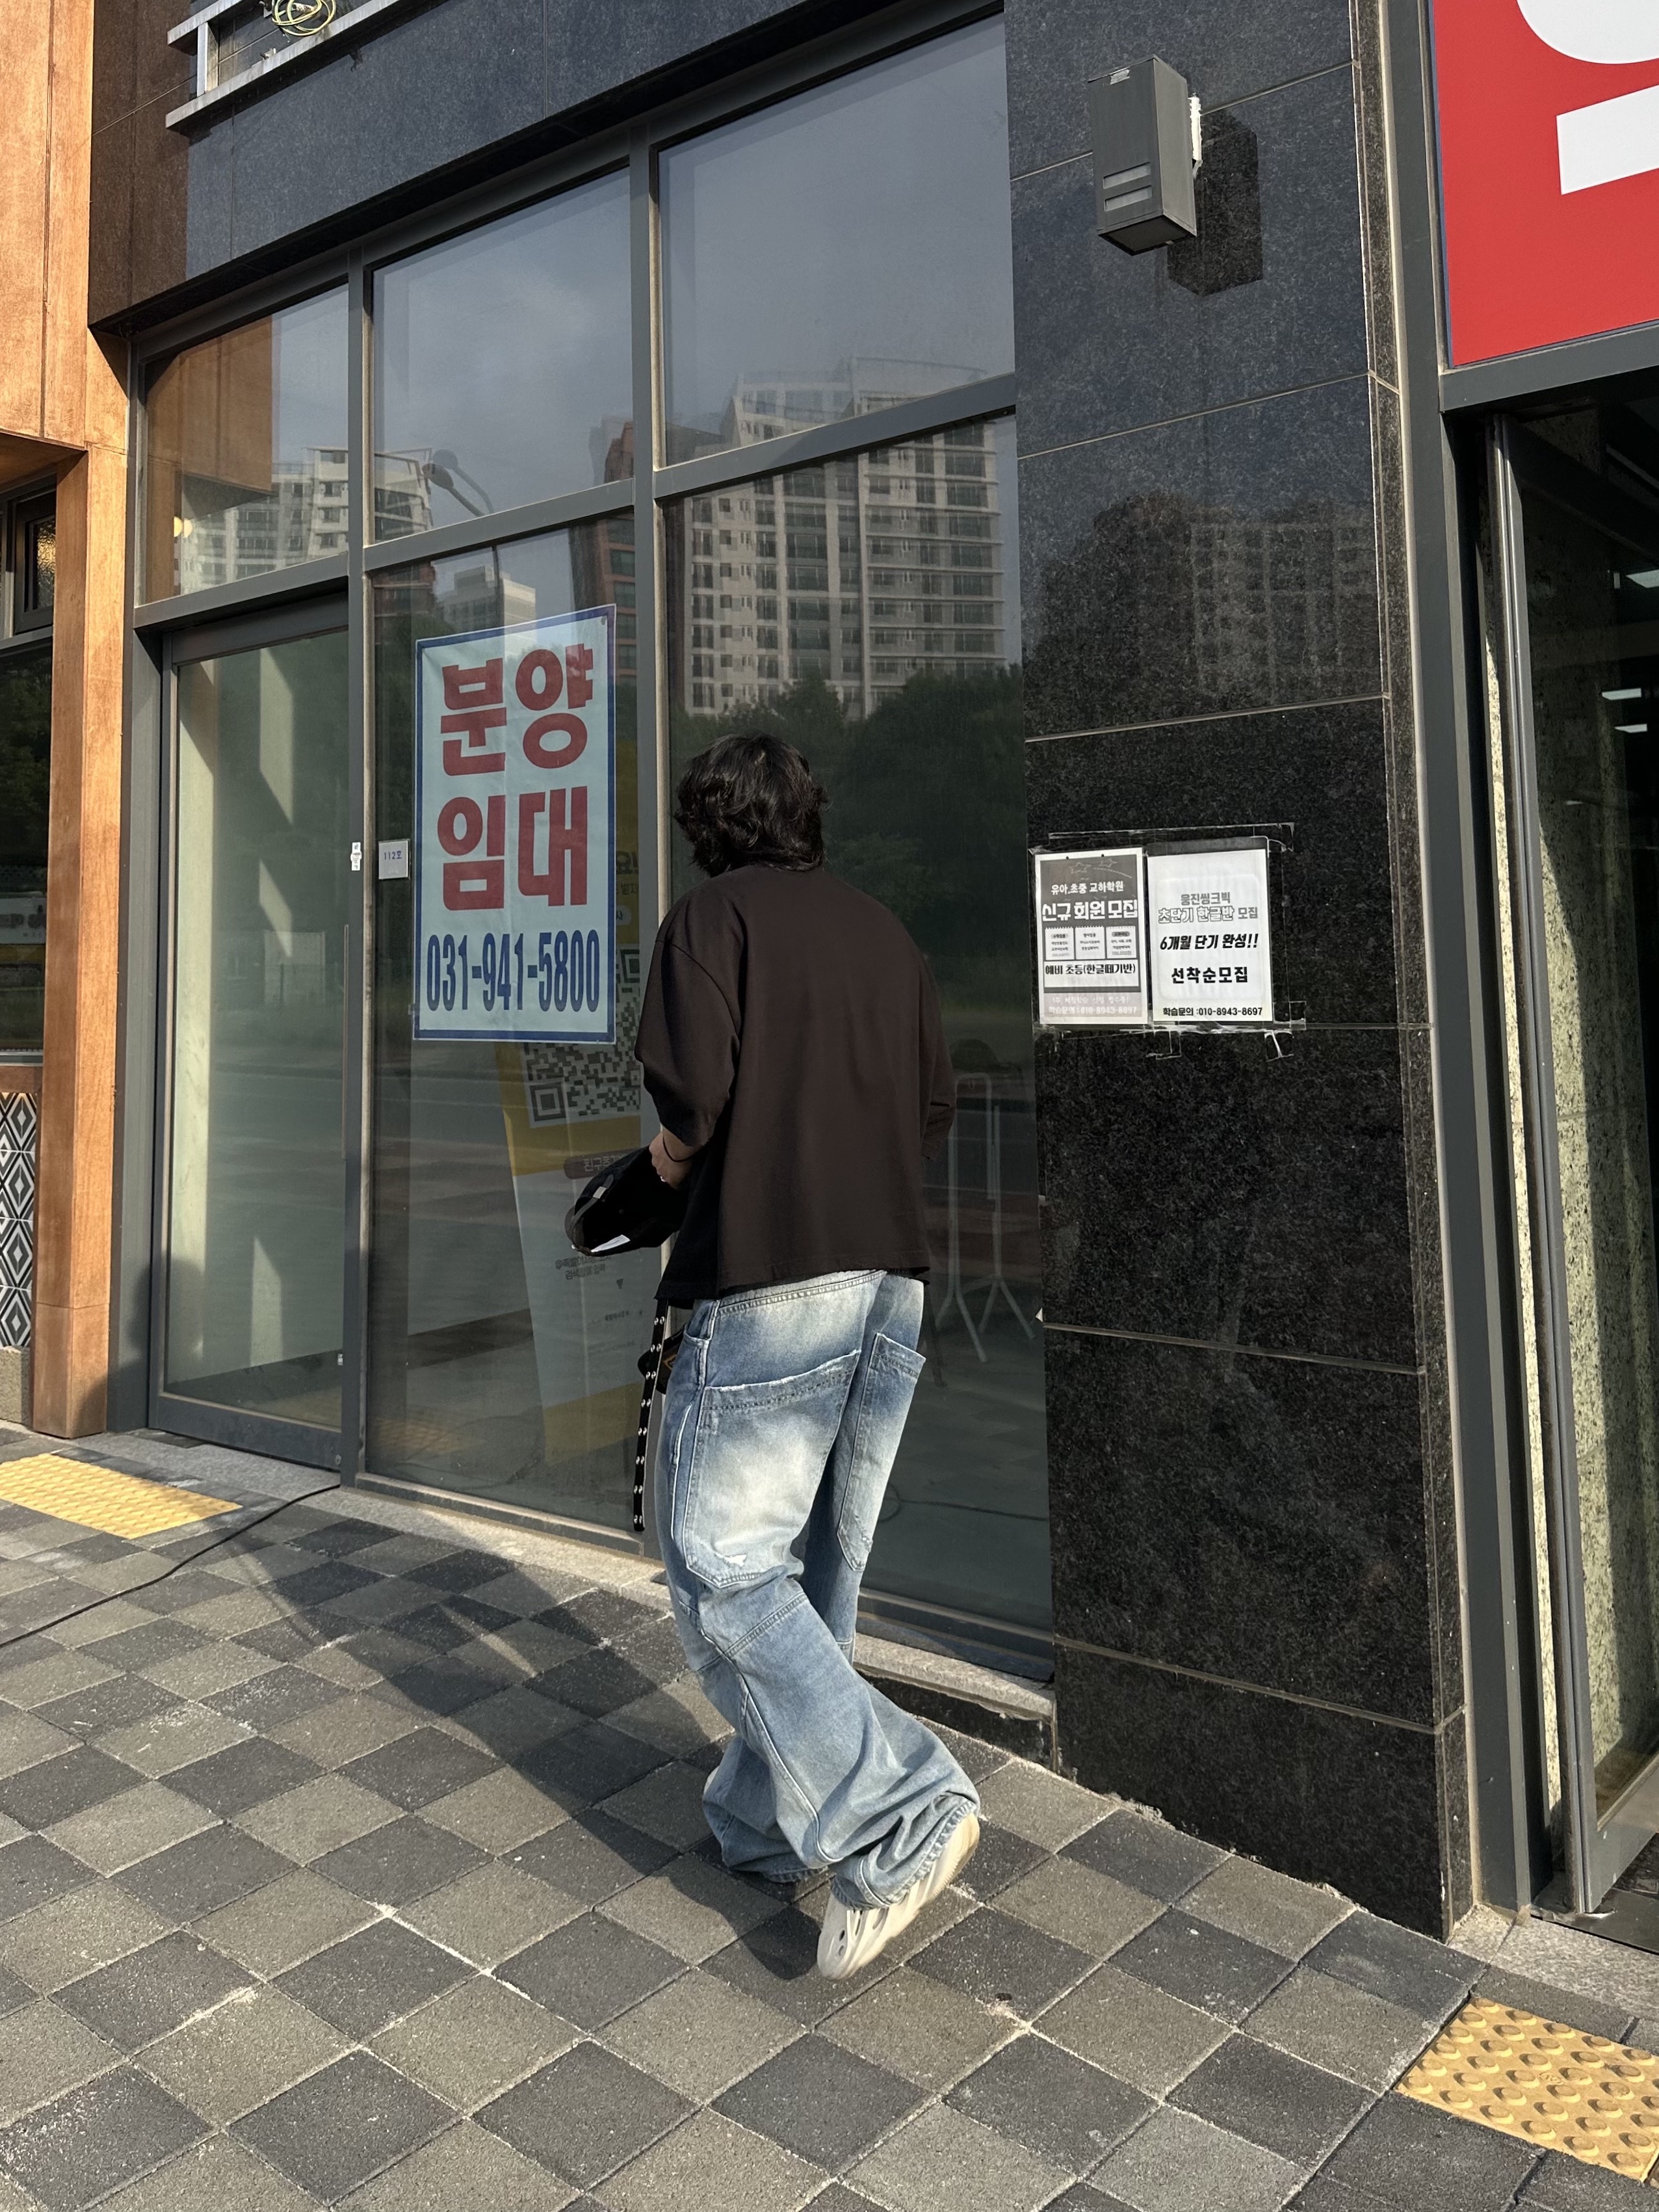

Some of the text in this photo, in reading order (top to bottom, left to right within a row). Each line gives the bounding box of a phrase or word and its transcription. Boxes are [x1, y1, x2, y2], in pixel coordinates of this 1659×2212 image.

[440, 642, 594, 776] 분양
[384, 850, 402, 860] 112호
[438, 786, 588, 910] 임대
[1090, 881, 1123, 892] 교하학원
[1181, 892, 1231, 906] 웅진씽크빅
[1042, 899, 1138, 921] 신규 회원 모집
[1158, 906, 1258, 924] 초단기 한글반 모집
[1160, 933, 1259, 950] 6개월 단기 완성!!
[427, 930, 599, 1012] 031-941-5800
[1045, 964, 1136, 975] 예비 초등(한글떼기반)
[1171, 966, 1248, 984] 선착순모집
[1162, 1007, 1194, 1016] 학습문의
